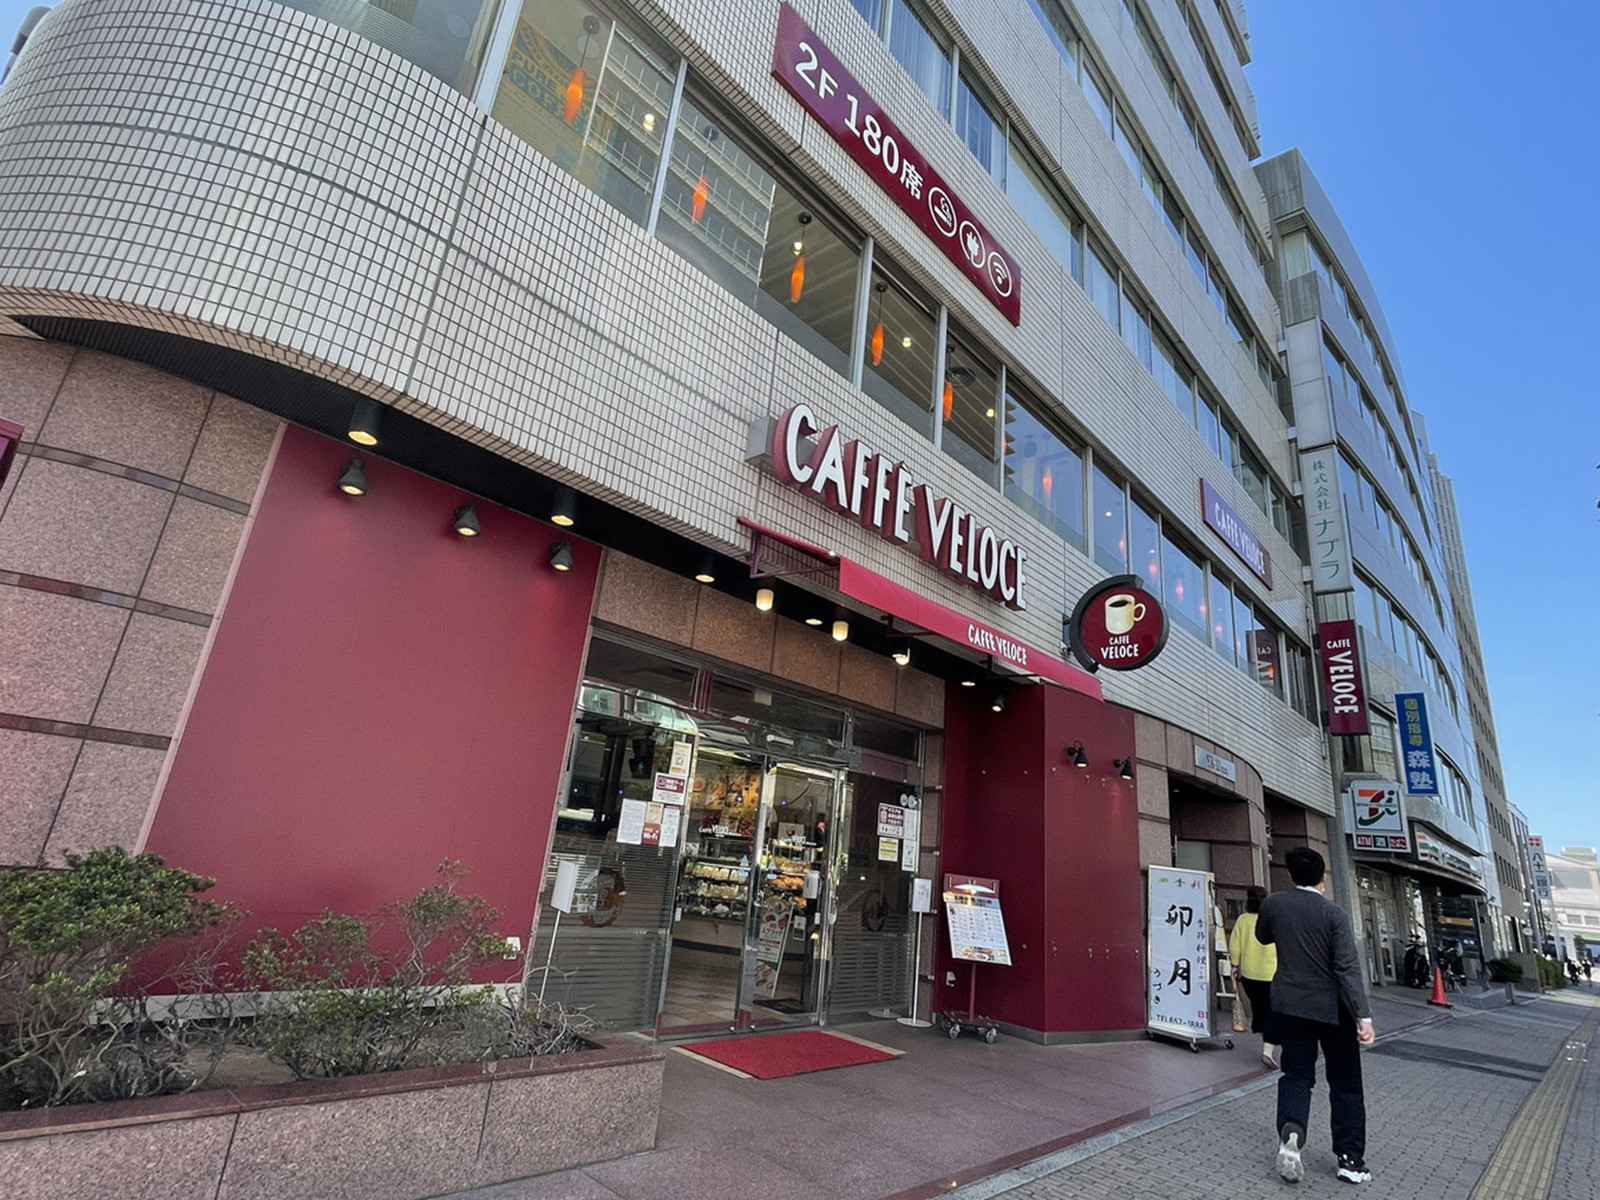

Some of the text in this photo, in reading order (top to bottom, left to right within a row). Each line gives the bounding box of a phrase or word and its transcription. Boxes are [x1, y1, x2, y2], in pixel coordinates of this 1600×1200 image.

[795, 42, 923, 200] 2F 180席
[1312, 459, 1331, 511] 株式会社
[922, 485, 1027, 610] VELOCE
[1214, 502, 1266, 575] CAFFE VELOCE
[968, 623, 1028, 666] CAFFE VELOCE
[1100, 643, 1139, 660] VELOCE
[1109, 635, 1130, 646] CAFFE
[1326, 638, 1351, 650] CAFFE
[1328, 650, 1359, 714] VELOCE
[1408, 749, 1434, 790] 森塾
[1357, 836, 1372, 846] ATM
